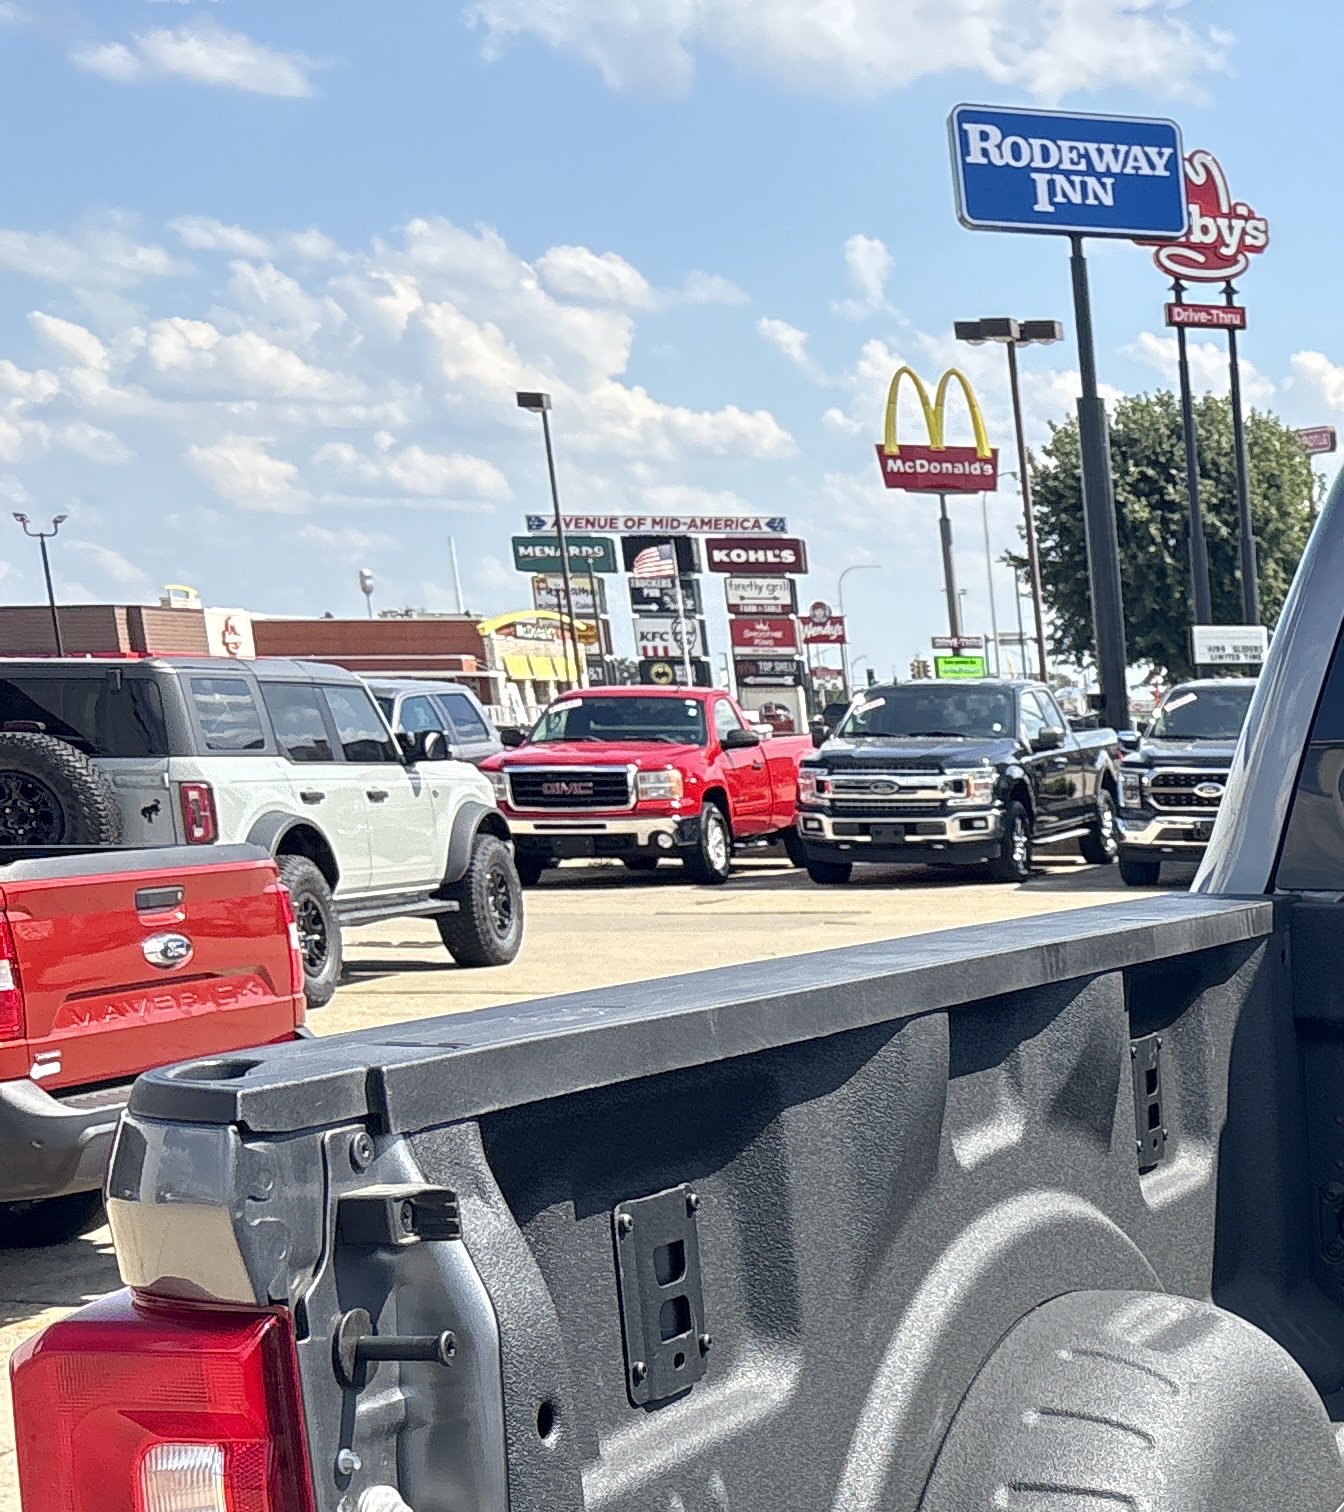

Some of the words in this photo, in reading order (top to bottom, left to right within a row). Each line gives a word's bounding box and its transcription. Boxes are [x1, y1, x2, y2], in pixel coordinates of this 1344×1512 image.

[962, 122, 1174, 178] RODEWAY
[1031, 172, 1116, 213] INN
[1186, 204, 1268, 256] by's
[1172, 305, 1241, 325] Drive-Thru
[885, 458, 994, 477] McDonald's
[551, 517, 619, 530] AVENUE
[623, 517, 647, 530] OF
[651, 517, 763, 531] MID-AMERICA
[711, 549, 797, 564] KOHL'S
[639, 631, 671, 642] KFC
[542, 781, 594, 796] GMC
